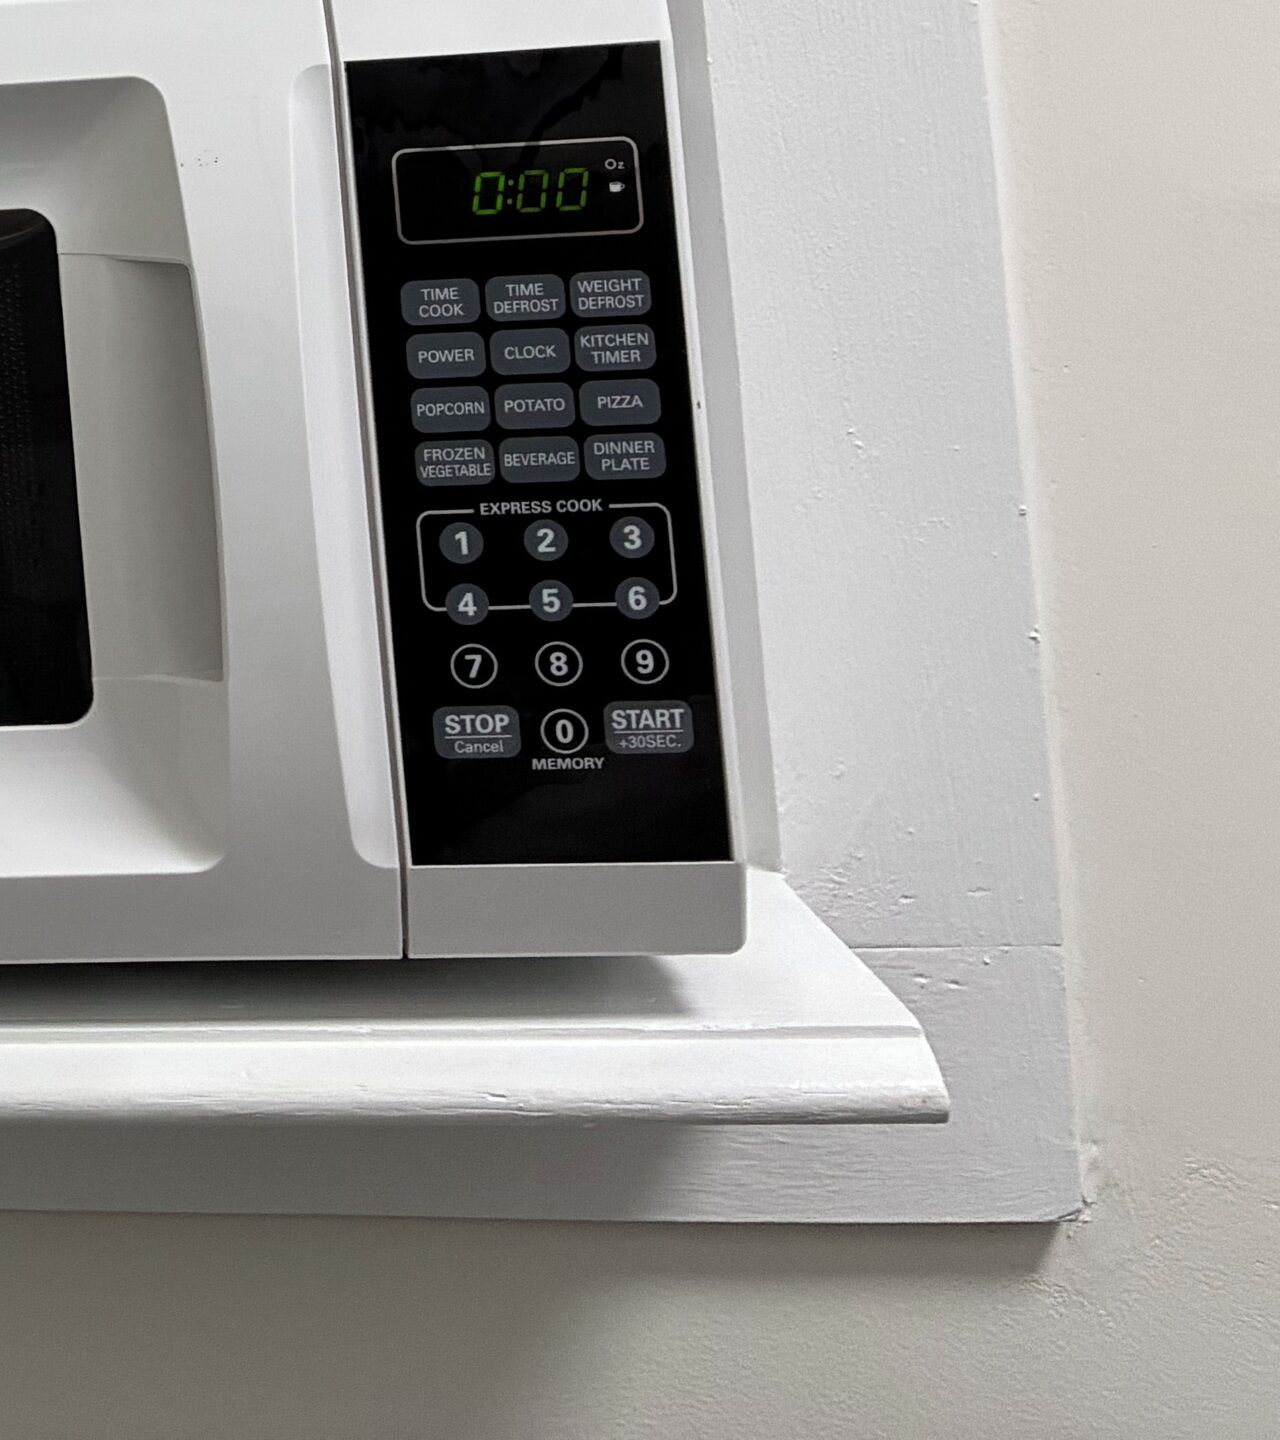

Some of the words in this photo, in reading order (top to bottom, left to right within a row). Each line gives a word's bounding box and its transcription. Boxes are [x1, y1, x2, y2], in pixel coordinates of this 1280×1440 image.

[471, 167, 590, 216] 0:00
[421, 287, 459, 301] TIME
[505, 283, 544, 298] TIME
[577, 278, 642, 294] WEIGHT
[418, 302, 465, 318] COOK
[493, 298, 559, 314] DEFROST
[578, 294, 645, 310] DEFROST
[580, 332, 649, 348] KITCHEN
[417, 348, 475, 364] POWER
[503, 345, 557, 360] CLOCK
[591, 349, 641, 365] TIMER
[416, 401, 485, 418] POPCORN
[503, 397, 566, 414] POTATO
[596, 394, 643, 410] PIZZA
[423, 447, 486, 462] FROZEN
[593, 440, 655, 456] DINNER
[503, 451, 576, 468] BEVERAGE
[601, 456, 651, 473] PLATE
[420, 462, 491, 478] VEGETABLE
[479, 500, 552, 516] EXPRESS
[555, 499, 603, 514] COOK
[454, 531, 469, 556] 1
[536, 528, 556, 553] 2
[623, 525, 642, 550] 3
[457, 593, 477, 617] 4
[542, 588, 561, 613] 5
[628, 585, 647, 611] 6
[464, 654, 483, 679] 7
[549, 651, 569, 677] 8
[635, 649, 655, 674] 9
[444, 713, 510, 735] STOP
[611, 708, 685, 730] START
[555, 719, 574, 744] 0
[454, 739, 504, 754] Cancel
[619, 733, 682, 750] +30SEC.
[532, 756, 605, 771] MEMORY
